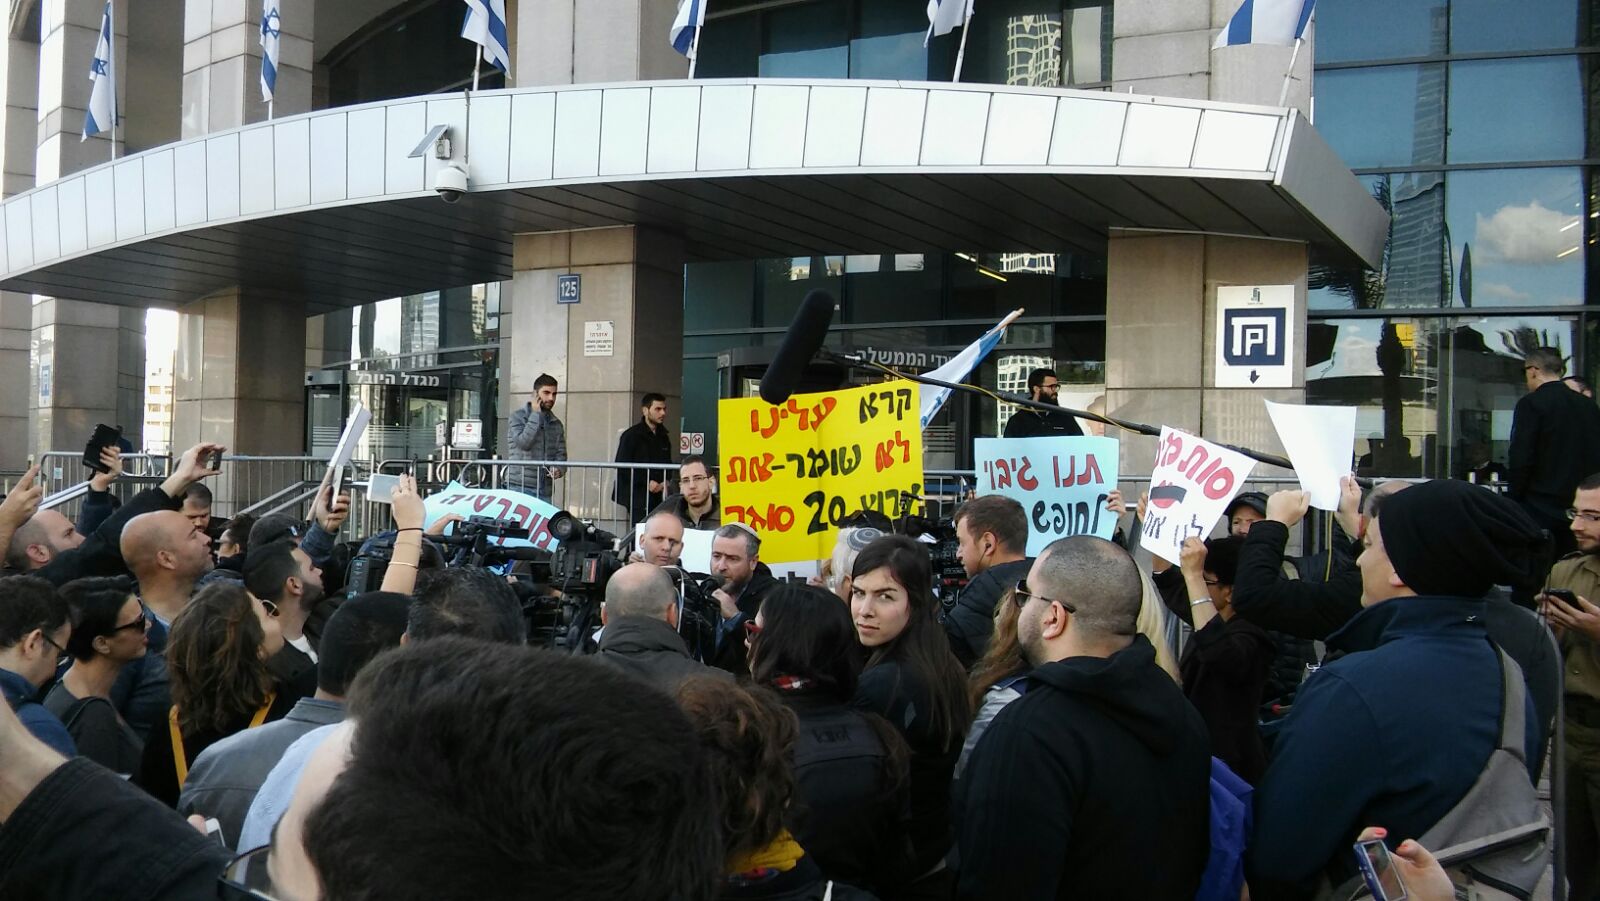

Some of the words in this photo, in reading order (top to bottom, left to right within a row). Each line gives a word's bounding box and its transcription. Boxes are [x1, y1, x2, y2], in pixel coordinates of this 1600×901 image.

[561, 281, 577, 297] 125
[355, 370, 396, 386] היובל
[401, 371, 440, 387] מגדל
[750, 396, 837, 439] עלינו
[859, 388, 912, 424] קרא
[875, 430, 910, 473] לא
[1053, 453, 1104, 488] תנו
[725, 503, 796, 532] סוגר
[803, 490, 847, 536] 20
